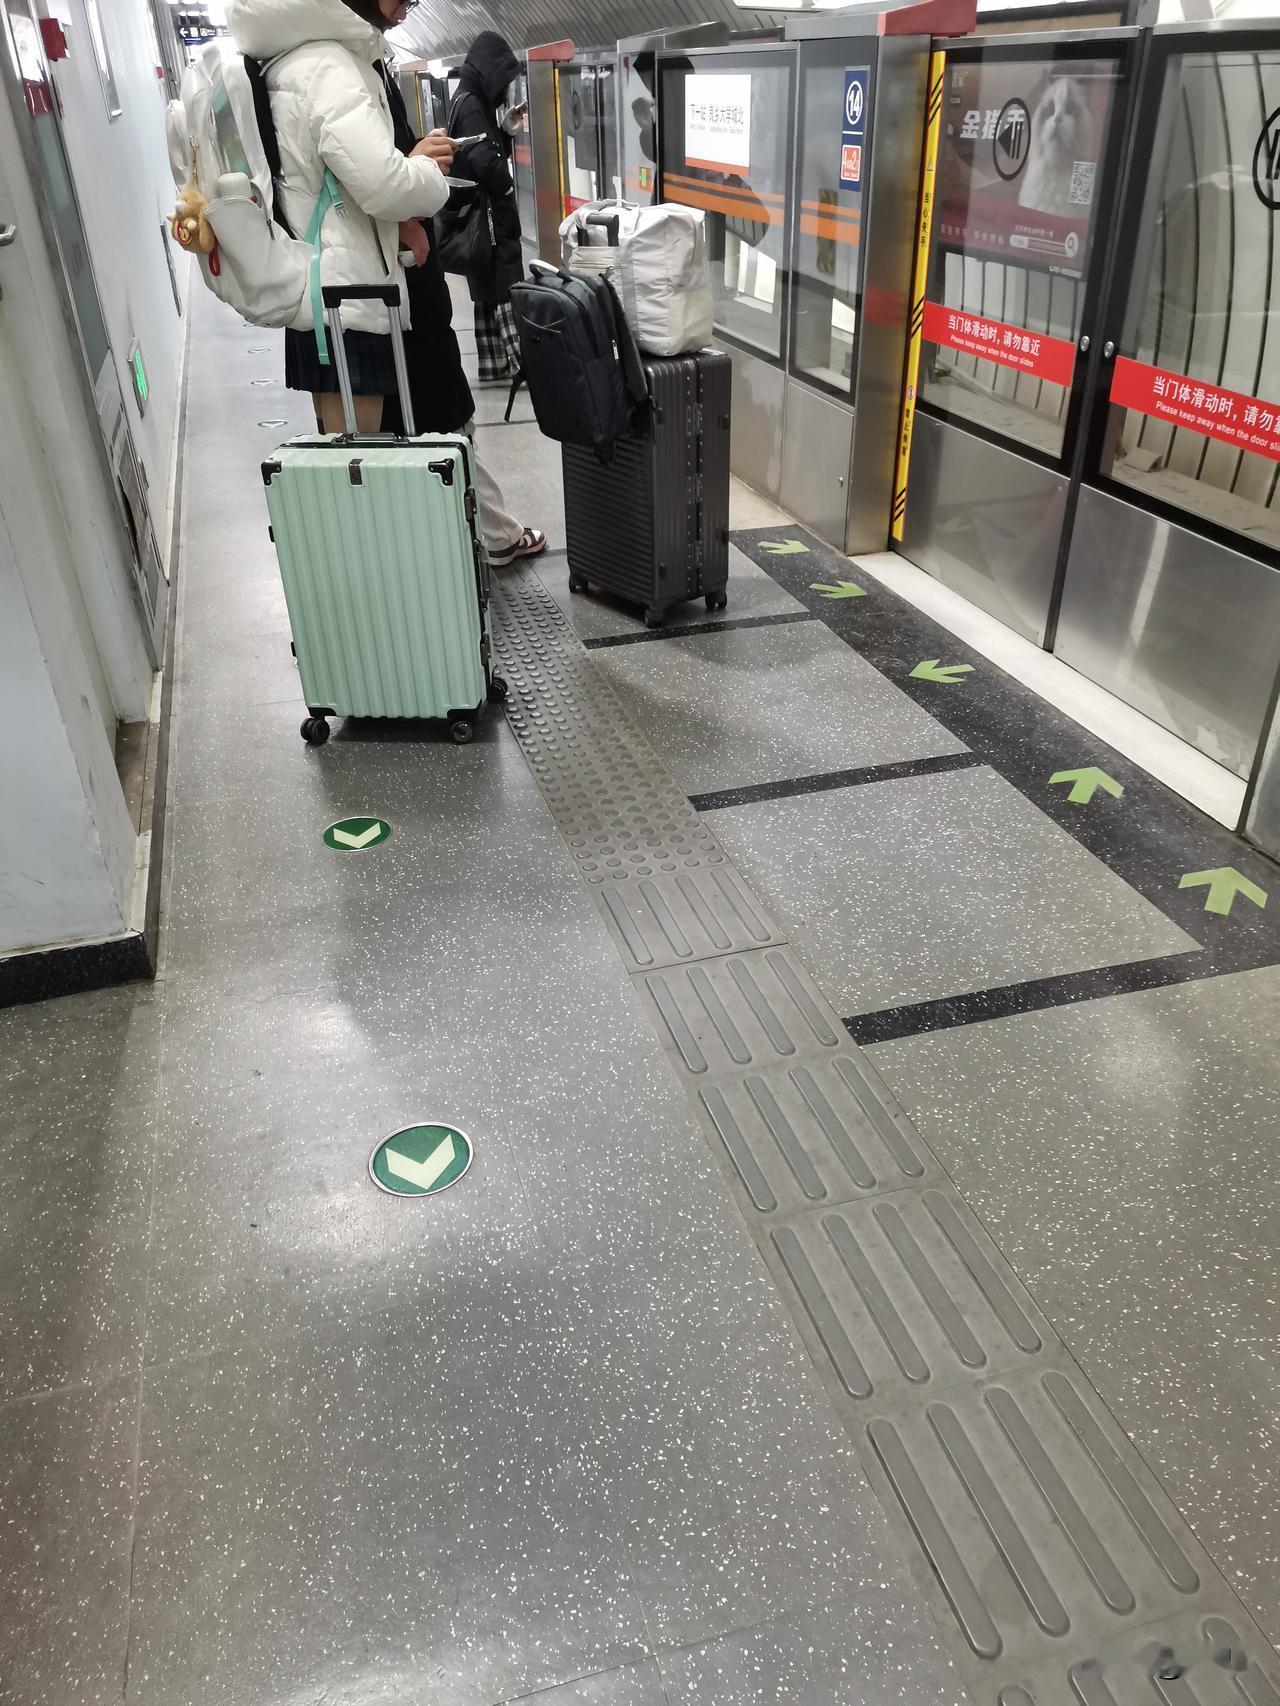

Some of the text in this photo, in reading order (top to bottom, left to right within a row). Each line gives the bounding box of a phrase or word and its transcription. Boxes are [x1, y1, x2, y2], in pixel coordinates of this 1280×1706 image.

[848, 89, 861, 117] 14
[950, 334, 1034, 368] Please keep away when the door slides
[1155, 400, 1178, 416] Please
[1179, 408, 1196, 423] keep
[1196, 416, 1215, 431] away
[1216, 421, 1235, 436] when
[1236, 429, 1249, 441] the
[1250, 434, 1269, 447] door
